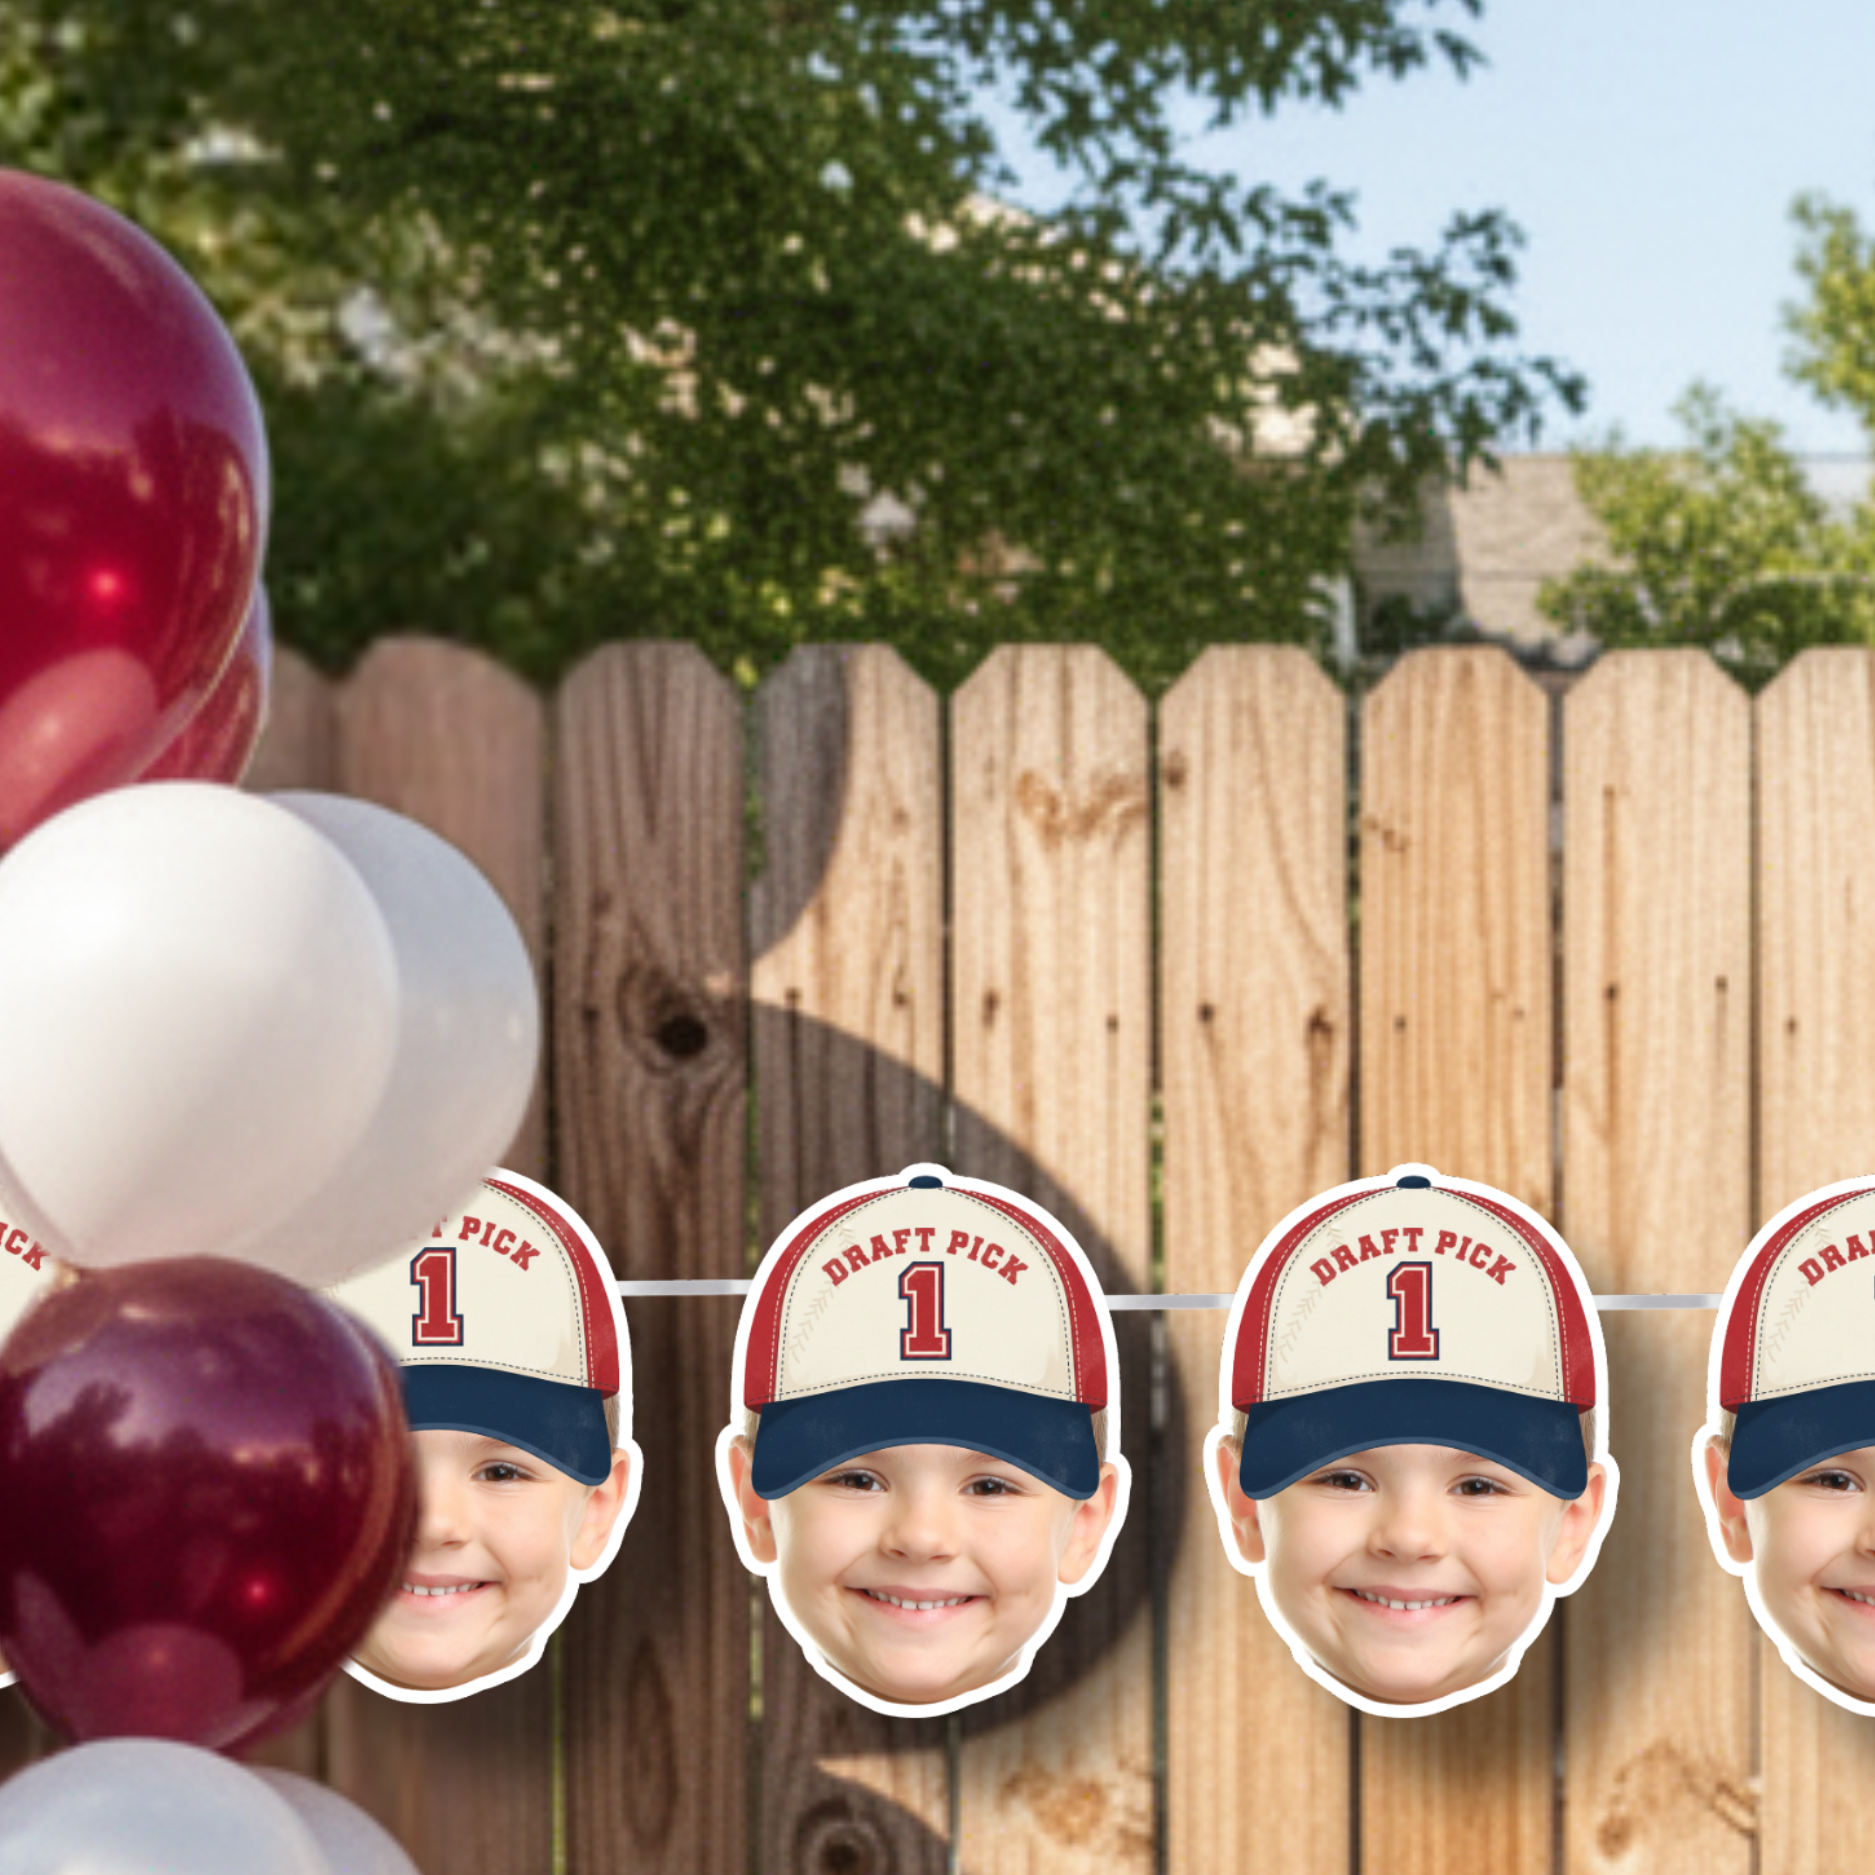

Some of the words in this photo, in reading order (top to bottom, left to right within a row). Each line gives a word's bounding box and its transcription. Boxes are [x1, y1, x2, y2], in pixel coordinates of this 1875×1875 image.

[458, 1215, 541, 1272] PICK
[821, 1227, 936, 1287] DRAFT
[945, 1229, 1029, 1287] PICK
[1309, 1227, 1424, 1287] DRAFT
[1433, 1229, 1517, 1287] PICK
[410, 1247, 464, 1347] 1
[898, 1261, 952, 1361] 1
[1386, 1261, 1440, 1361] 1
